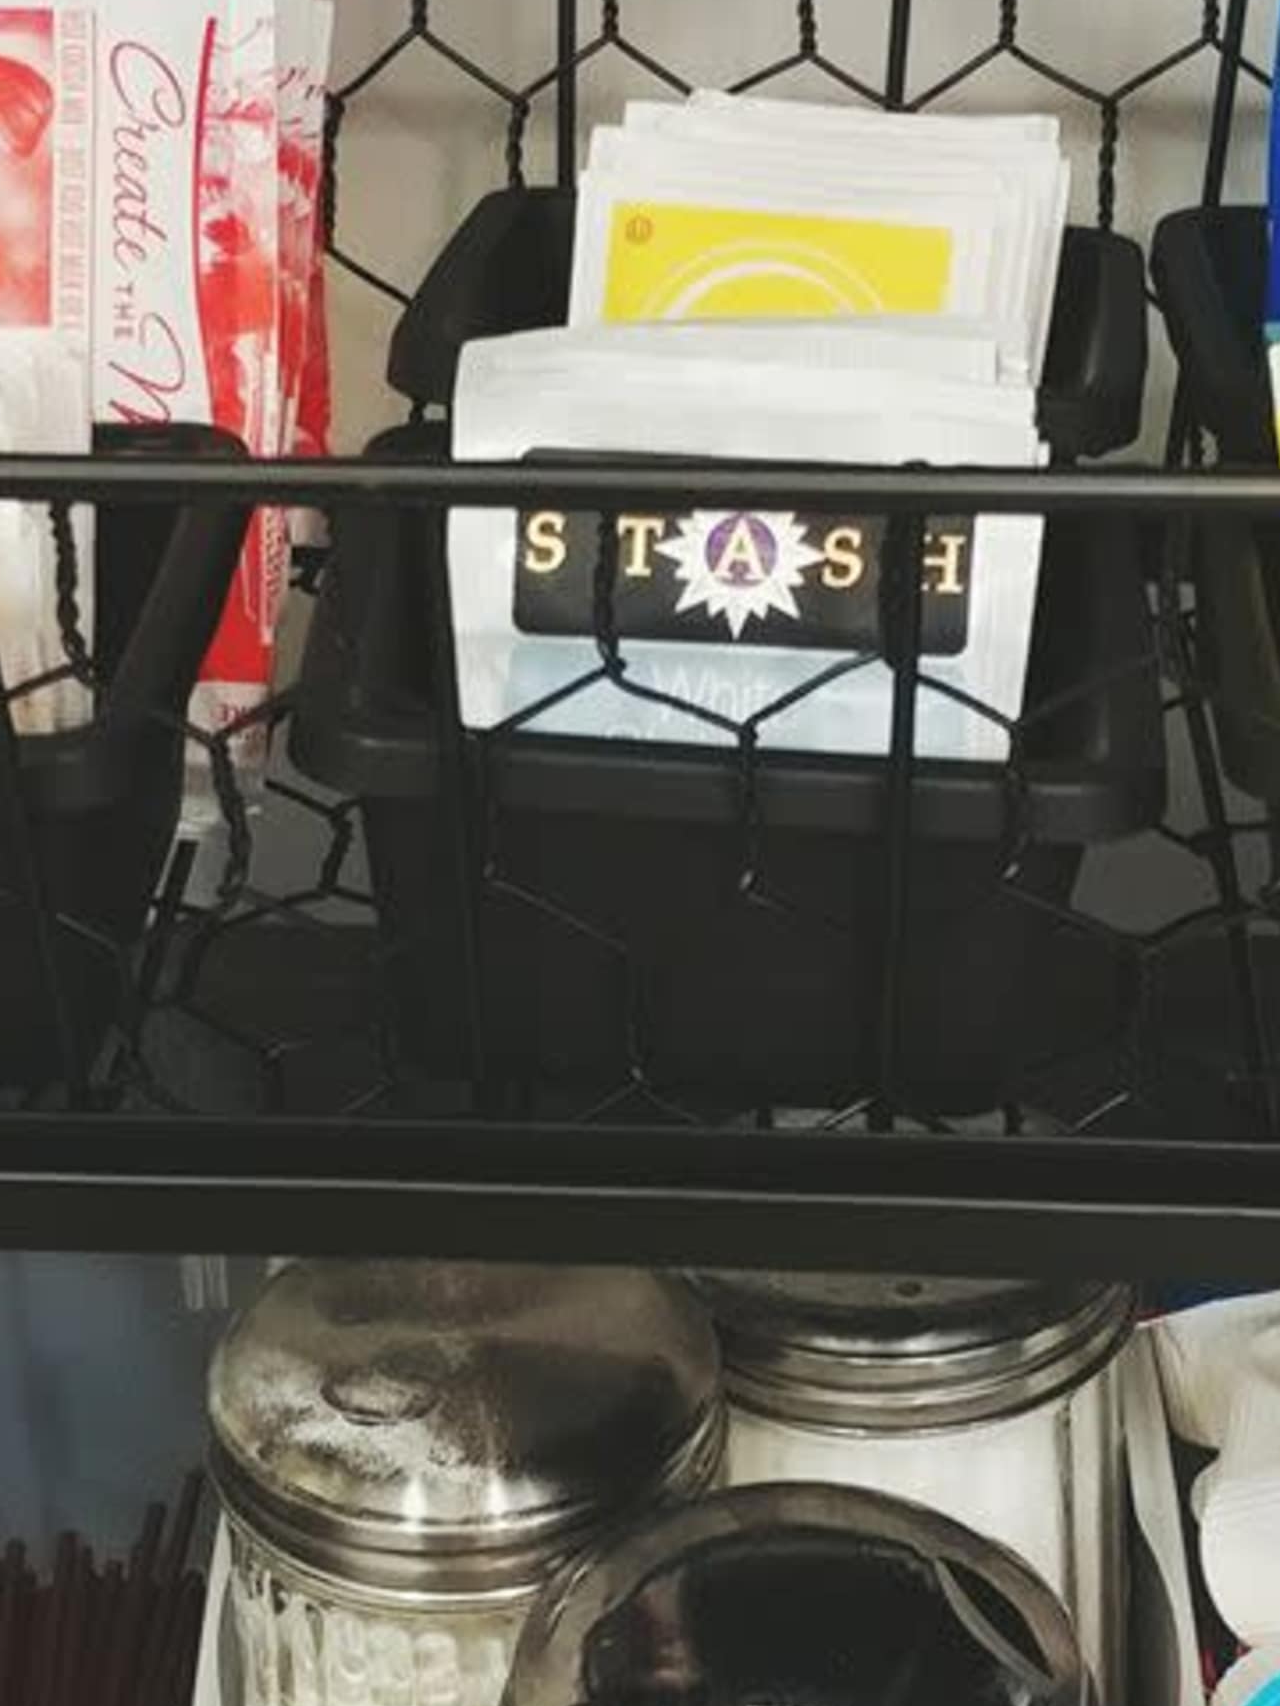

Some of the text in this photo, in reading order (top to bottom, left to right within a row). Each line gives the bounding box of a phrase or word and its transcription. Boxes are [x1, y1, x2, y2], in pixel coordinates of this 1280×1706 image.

[108, 40, 187, 272] Create
[114, 283, 136, 339] THE
[523, 511, 967, 594] STASH
